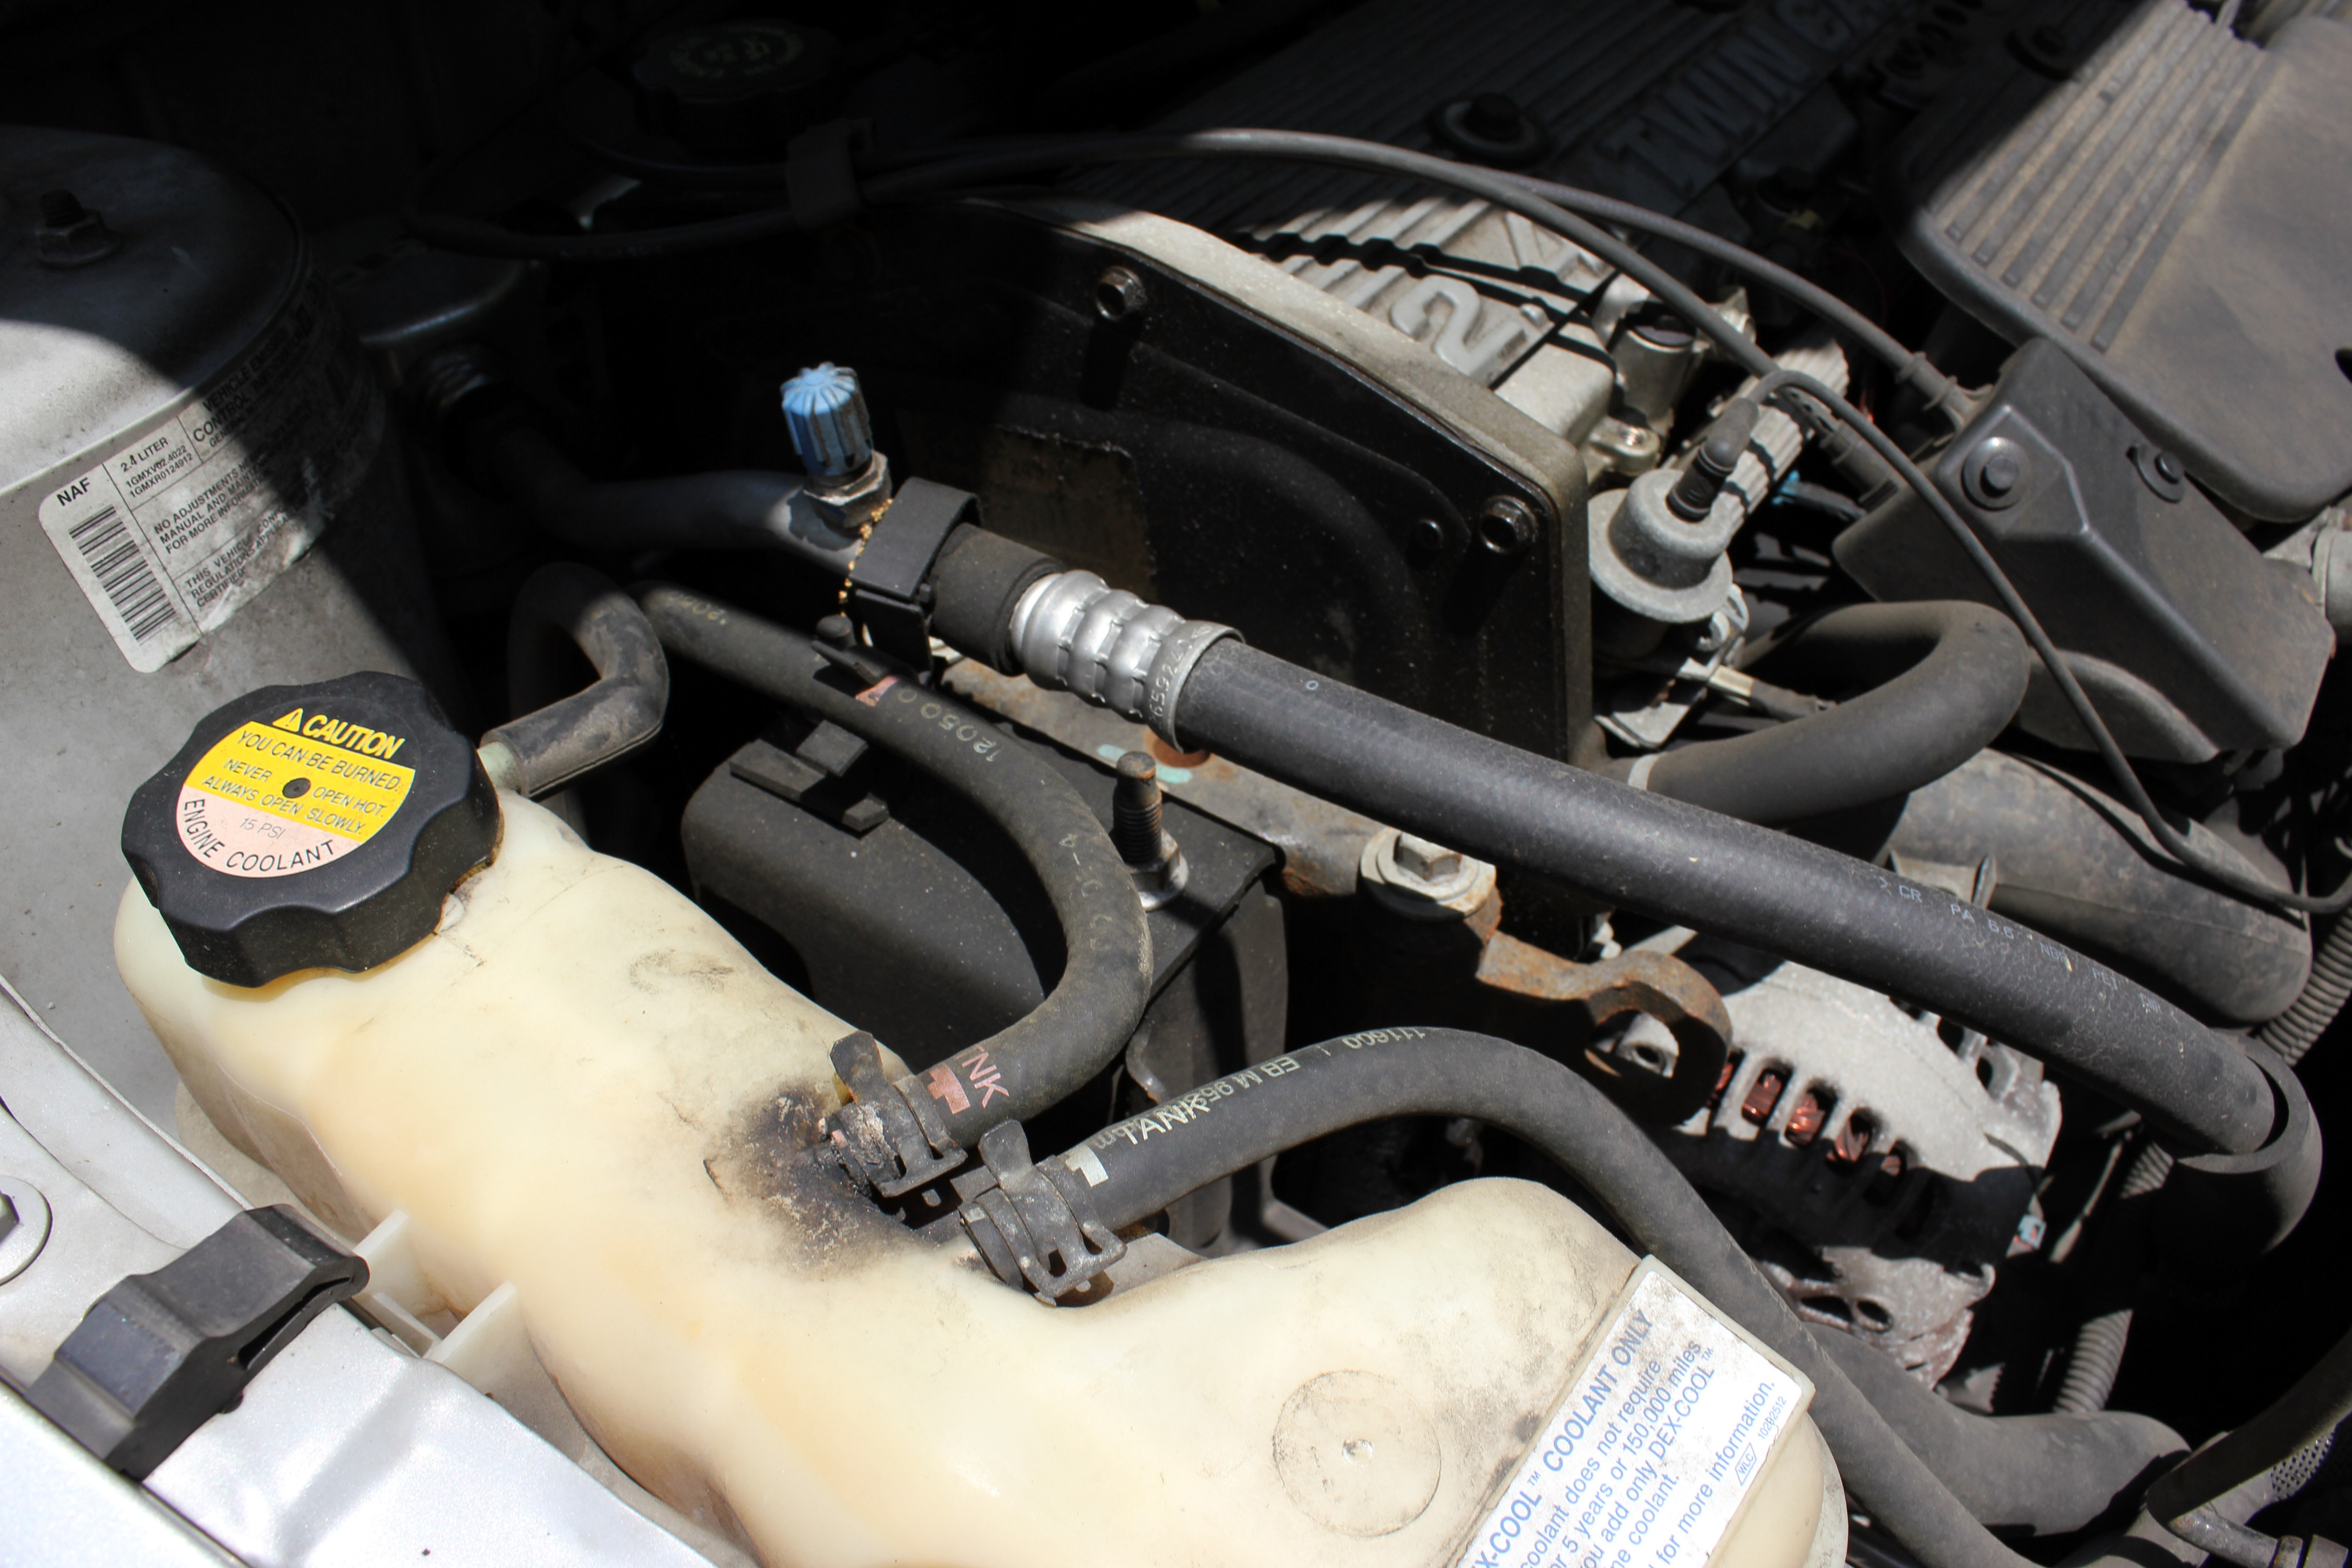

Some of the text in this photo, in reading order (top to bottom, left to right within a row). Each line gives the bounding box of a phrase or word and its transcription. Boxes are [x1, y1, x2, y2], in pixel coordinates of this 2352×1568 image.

[203, 366, 251, 412] VEHICLE
[193, 392, 251, 441] CONTROL
[121, 437, 169, 472] 2.4 LITER
[56, 477, 90, 506] NAF
[153, 518, 171, 534] NO
[173, 468, 239, 523] ADJUSTMENTS
[159, 511, 204, 545] MANUAL
[206, 492, 226, 513] AND
[165, 535, 189, 555] FOR
[188, 512, 218, 539] MORE
[185, 567, 211, 588] THIS
[191, 545, 255, 599] REGULATIONS
[236, 730, 402, 793] YOU CAN BE BURNED.
[302, 714, 405, 759] CAUTION
[201, 775, 366, 835] ALWAYS OPEN SLOWLY.
[223, 758, 387, 818] NEVER OPEN HOT.
[183, 798, 335, 872] ENGINE COOLANT
[239, 817, 286, 840] 15 PSI
[1898, 884, 1923, 904] CR
[1949, 903, 1976, 923] PA
[1122, 1094, 1211, 1146] TANK
[1470, 1490, 1543, 1568] X-COOL
[1543, 1364, 1617, 1472] COOLANT
[1611, 1309, 1653, 1367] ONLY
[1562, 1535, 1579, 1553] 5
[1574, 1482, 1614, 1540] years
[1610, 1457, 1628, 1481] or
[1622, 1386, 1672, 1456] 150,000
[1667, 1339, 1703, 1388] miles
[1565, 1457, 1601, 1505] does
[1597, 1422, 1623, 1456] not
[1617, 1359, 1662, 1423] require
[1580, 1543, 1605, 1568] ou
[1600, 1500, 1630, 1543] add
[1626, 1460, 1658, 1502] only
[1648, 1366, 1716, 1460] DEX-COOL
[1656, 1382, 1776, 1565] for more information.
[1628, 1473, 1680, 1546] coolant.
